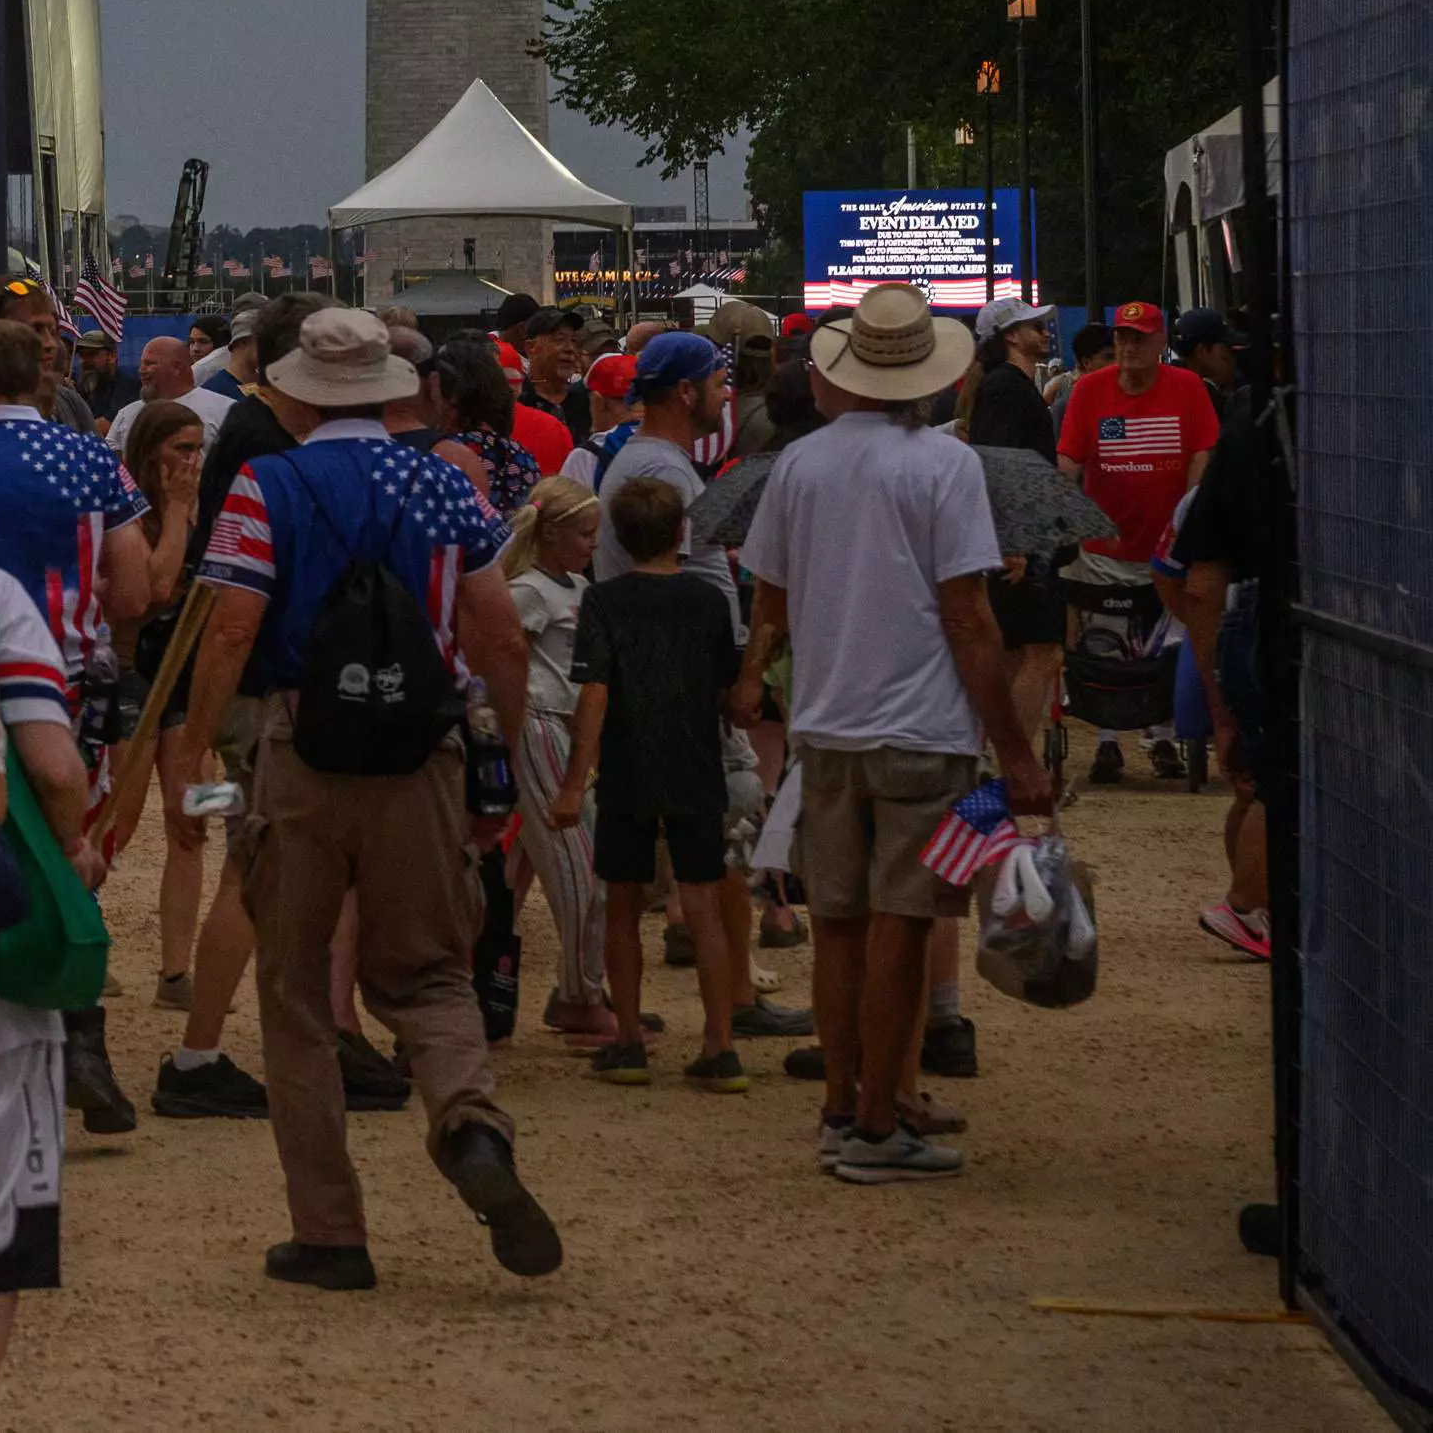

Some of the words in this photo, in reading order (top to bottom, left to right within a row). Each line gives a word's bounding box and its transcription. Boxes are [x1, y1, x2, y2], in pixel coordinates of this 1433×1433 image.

[840, 204, 857, 212] THE
[882, 195, 949, 216] American
[951, 202, 976, 210] STATE
[859, 216, 908, 230] EVENT
[909, 215, 980, 229] DELAYED
[828, 266, 864, 275] PLEASE
[864, 265, 910, 275] PROCEED
[910, 265, 924, 275] TO
[924, 265, 945, 274] THE
[555, 271, 579, 283] UTE
[1100, 461, 1154, 472] Freedom
